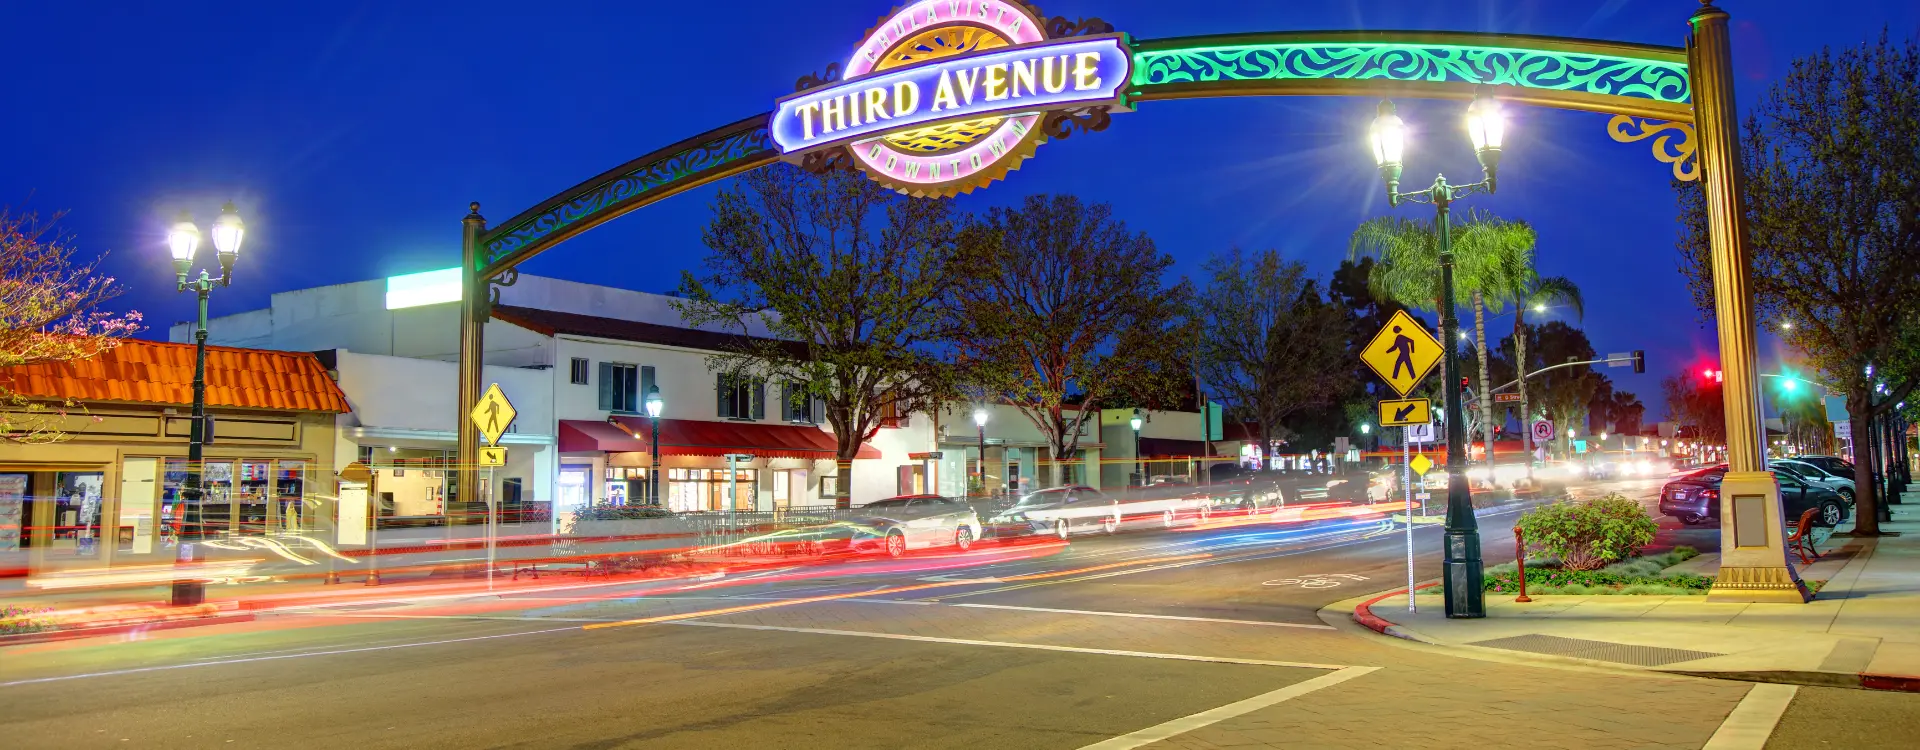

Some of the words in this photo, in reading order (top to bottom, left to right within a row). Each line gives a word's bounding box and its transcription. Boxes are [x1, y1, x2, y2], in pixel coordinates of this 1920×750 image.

[864, 7, 938, 63] CHULA
[948, 0, 1024, 34] VISTA
[795, 80, 920, 141] THIRD
[930, 51, 1102, 112] AVENUE
[868, 120, 1028, 180] DOWNTOWN
